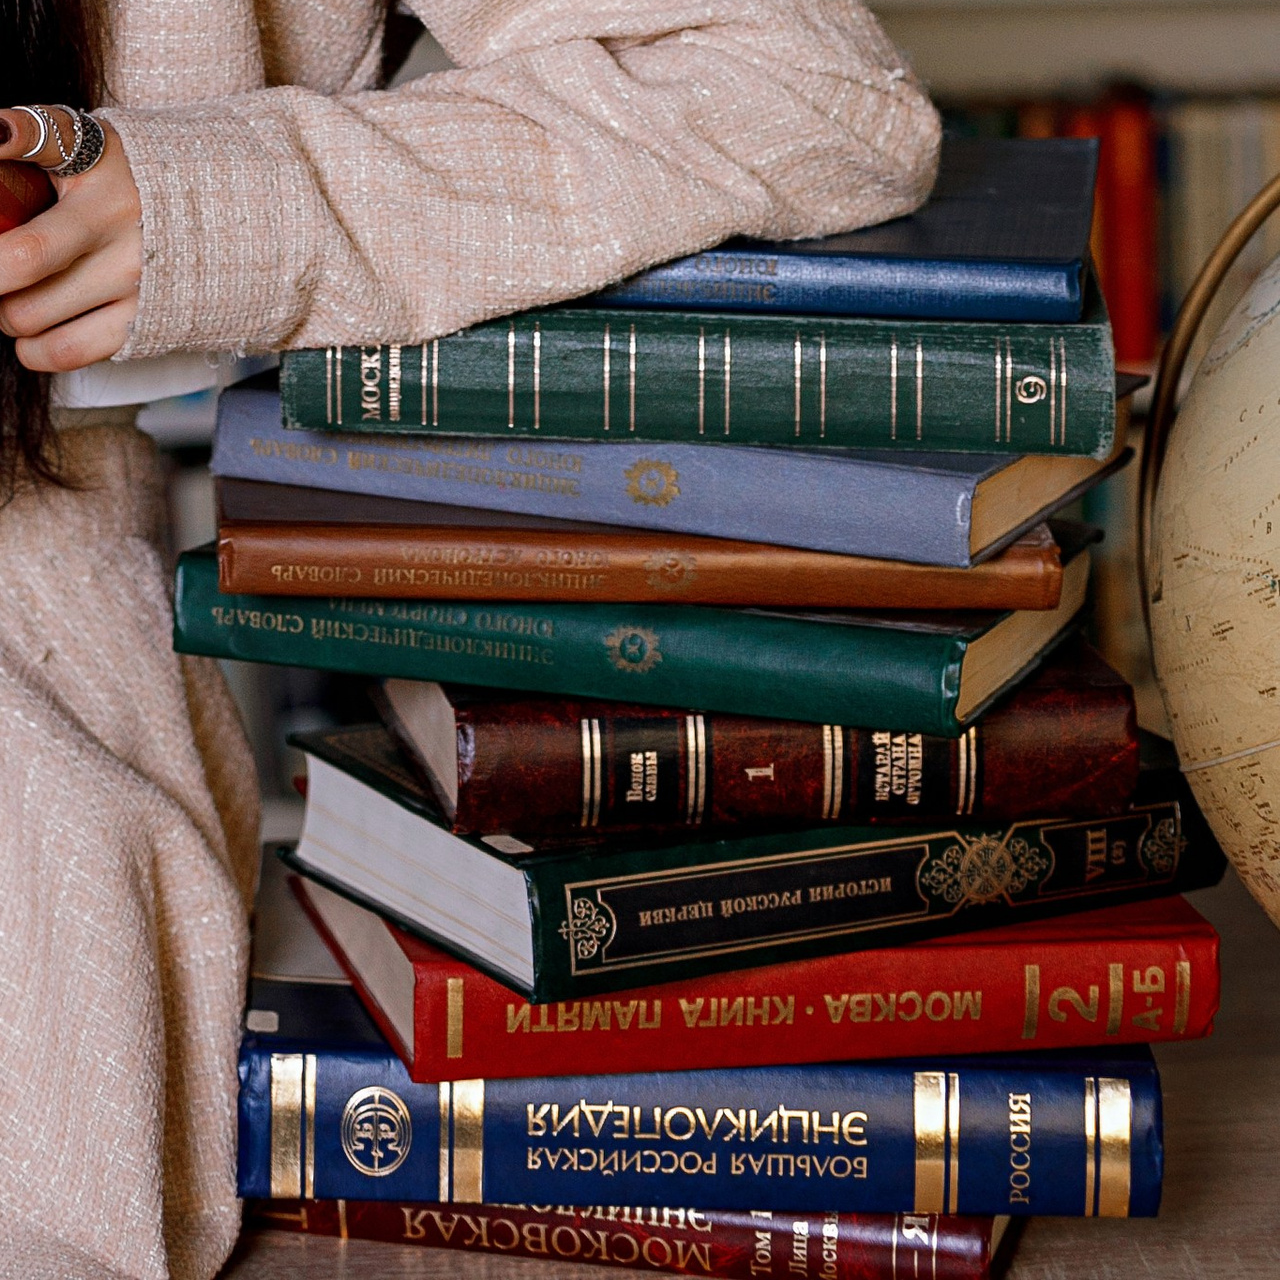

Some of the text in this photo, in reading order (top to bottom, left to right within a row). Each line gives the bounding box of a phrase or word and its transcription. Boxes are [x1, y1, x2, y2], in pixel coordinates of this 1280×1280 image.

[249, 438, 338, 467] СЛОВАРЬ
[347, 450, 582, 499] ЭНЦИКЛОПЕДИЧЕСКИЙ
[505, 446, 583, 475] ЮНОГО
[270, 564, 607, 591] ЭНЦИКЛОПЕДИЧЕСКИЙ СЛОВАРЬ
[400, 545, 611, 570] ЮНОГО АСТРОНОМА
[209, 606, 556, 666] ЭНЦИКЛОПЕДИЧЕСКИЙ СЛОВАРЬ
[474, 612, 556, 638] ЮНОГО
[625, 751, 645, 803] Венок
[643, 750, 658, 802] славы
[744, 762, 775, 782] 1
[891, 732, 907, 796] СТРАНА
[906, 732, 923, 806] ОГРОМНА
[1085, 828, 1107, 883] VIII
[637, 875, 893, 928] ИСТОРИЯ РУССКОЙ ЦЕРКВИ
[505, 989, 983, 1033] МОСКВА КНИГА ПАМЯТИ
[1047, 984, 1100, 1023] 2
[525, 1098, 869, 1146] ЭНЦИКЛОПЕДИЯ
[526, 1146, 868, 1180] БОЛЬШАЯ РОССИЙСКАЯ
[1008, 1092, 1032, 1205] РОССИЯ
[399, 1206, 712, 1273] МОСКОВСКАЯ
[749, 1231, 773, 1277] Том
[788, 1221, 811, 1278] Лица
